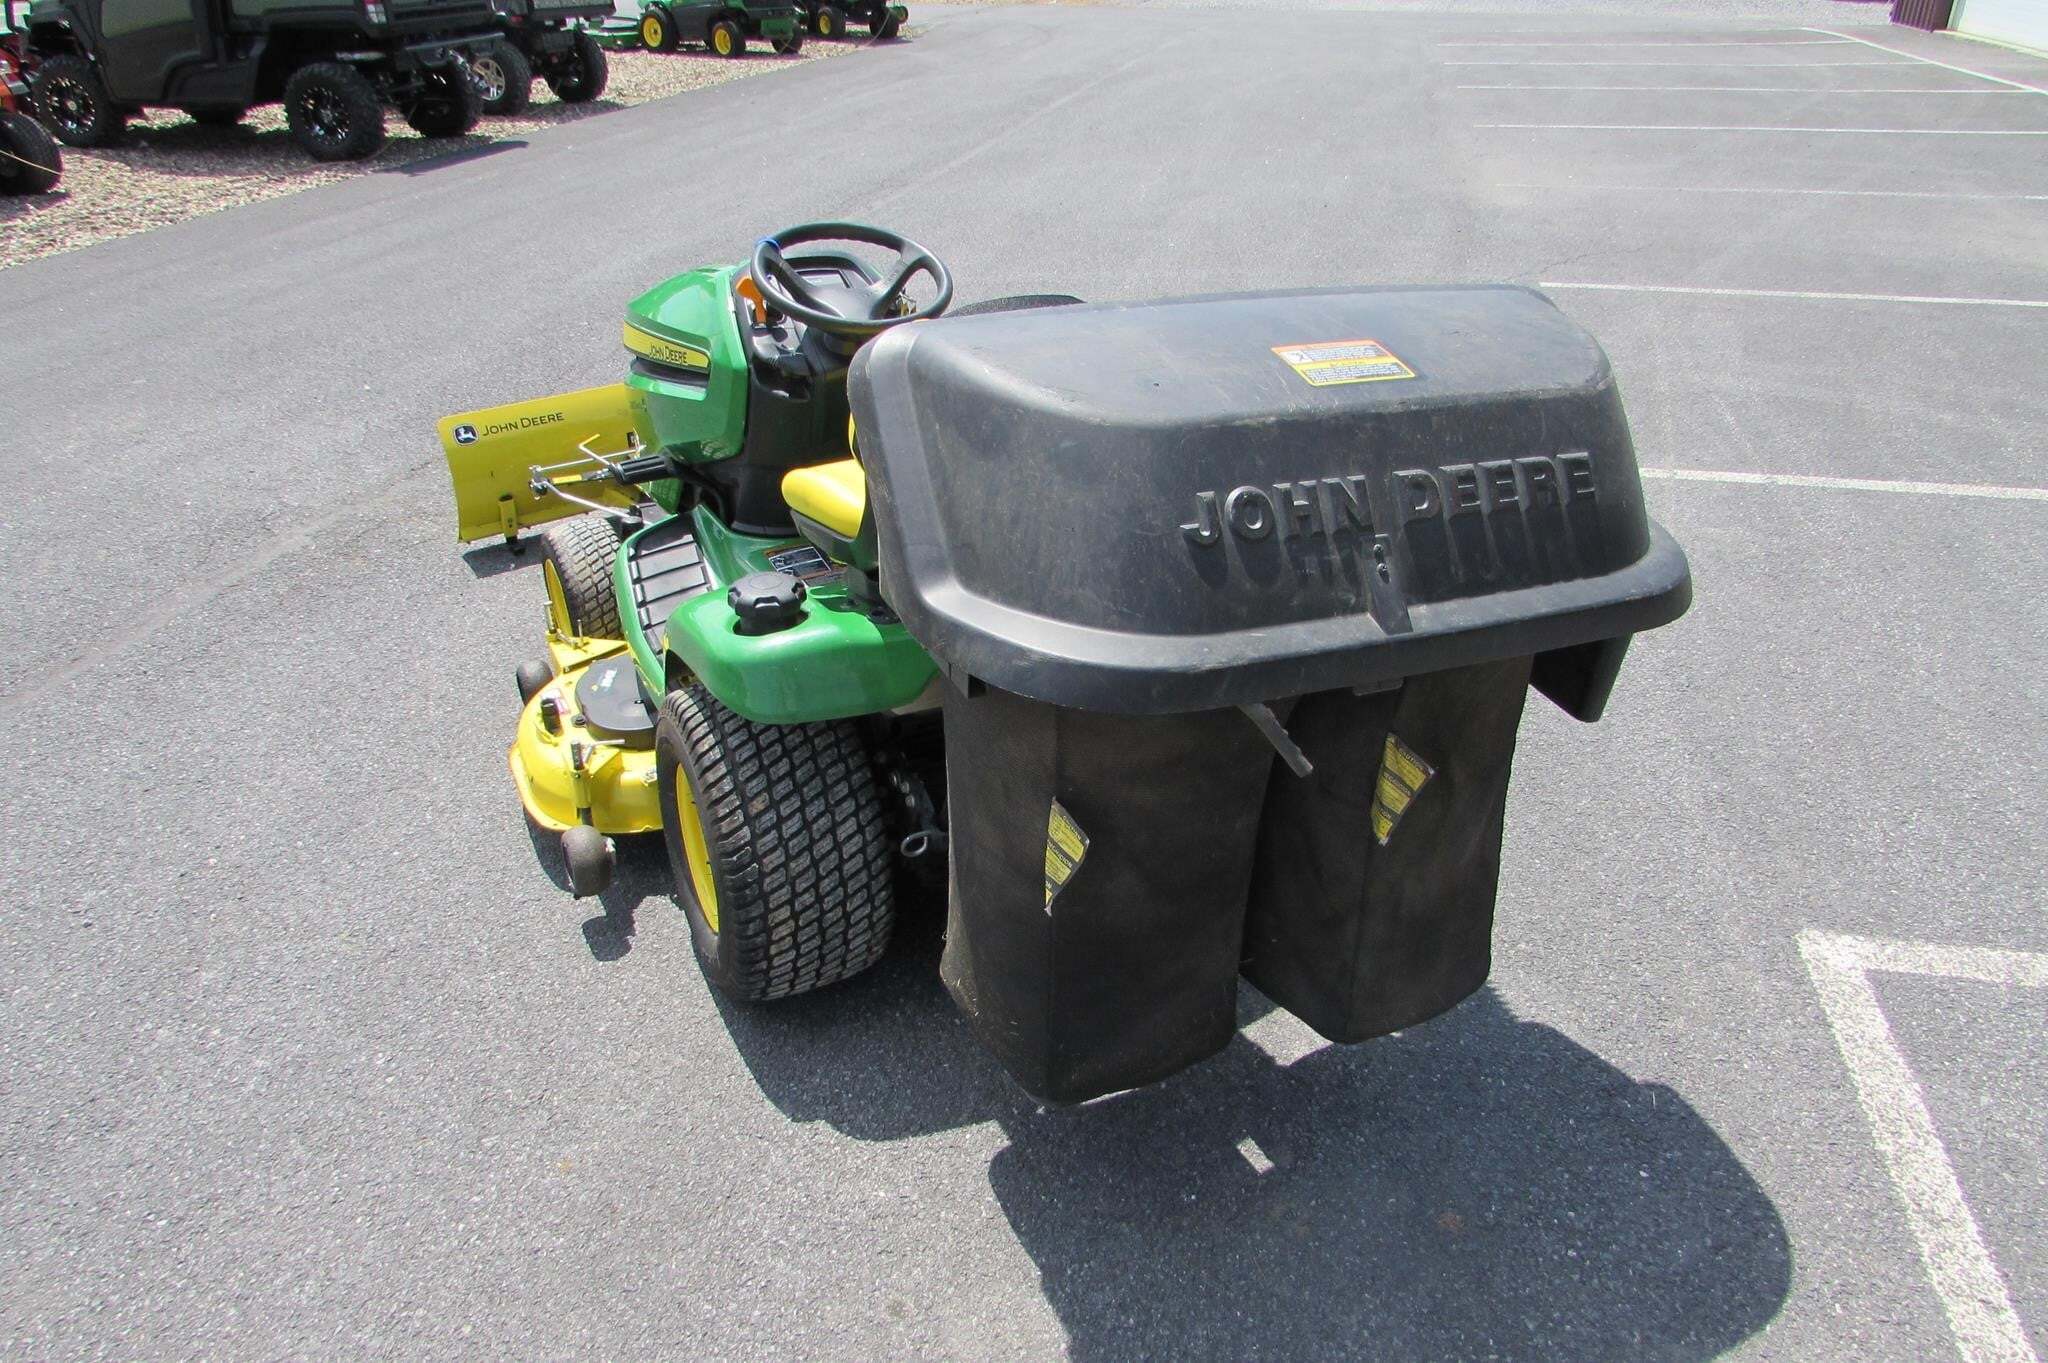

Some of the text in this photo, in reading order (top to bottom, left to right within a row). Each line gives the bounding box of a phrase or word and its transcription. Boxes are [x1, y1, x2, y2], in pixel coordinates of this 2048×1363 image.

[649, 343, 688, 364] JOHN DEERE
[482, 412, 565, 437] JOHN DEERE
[1178, 451, 1597, 546] JOHN DEERE
